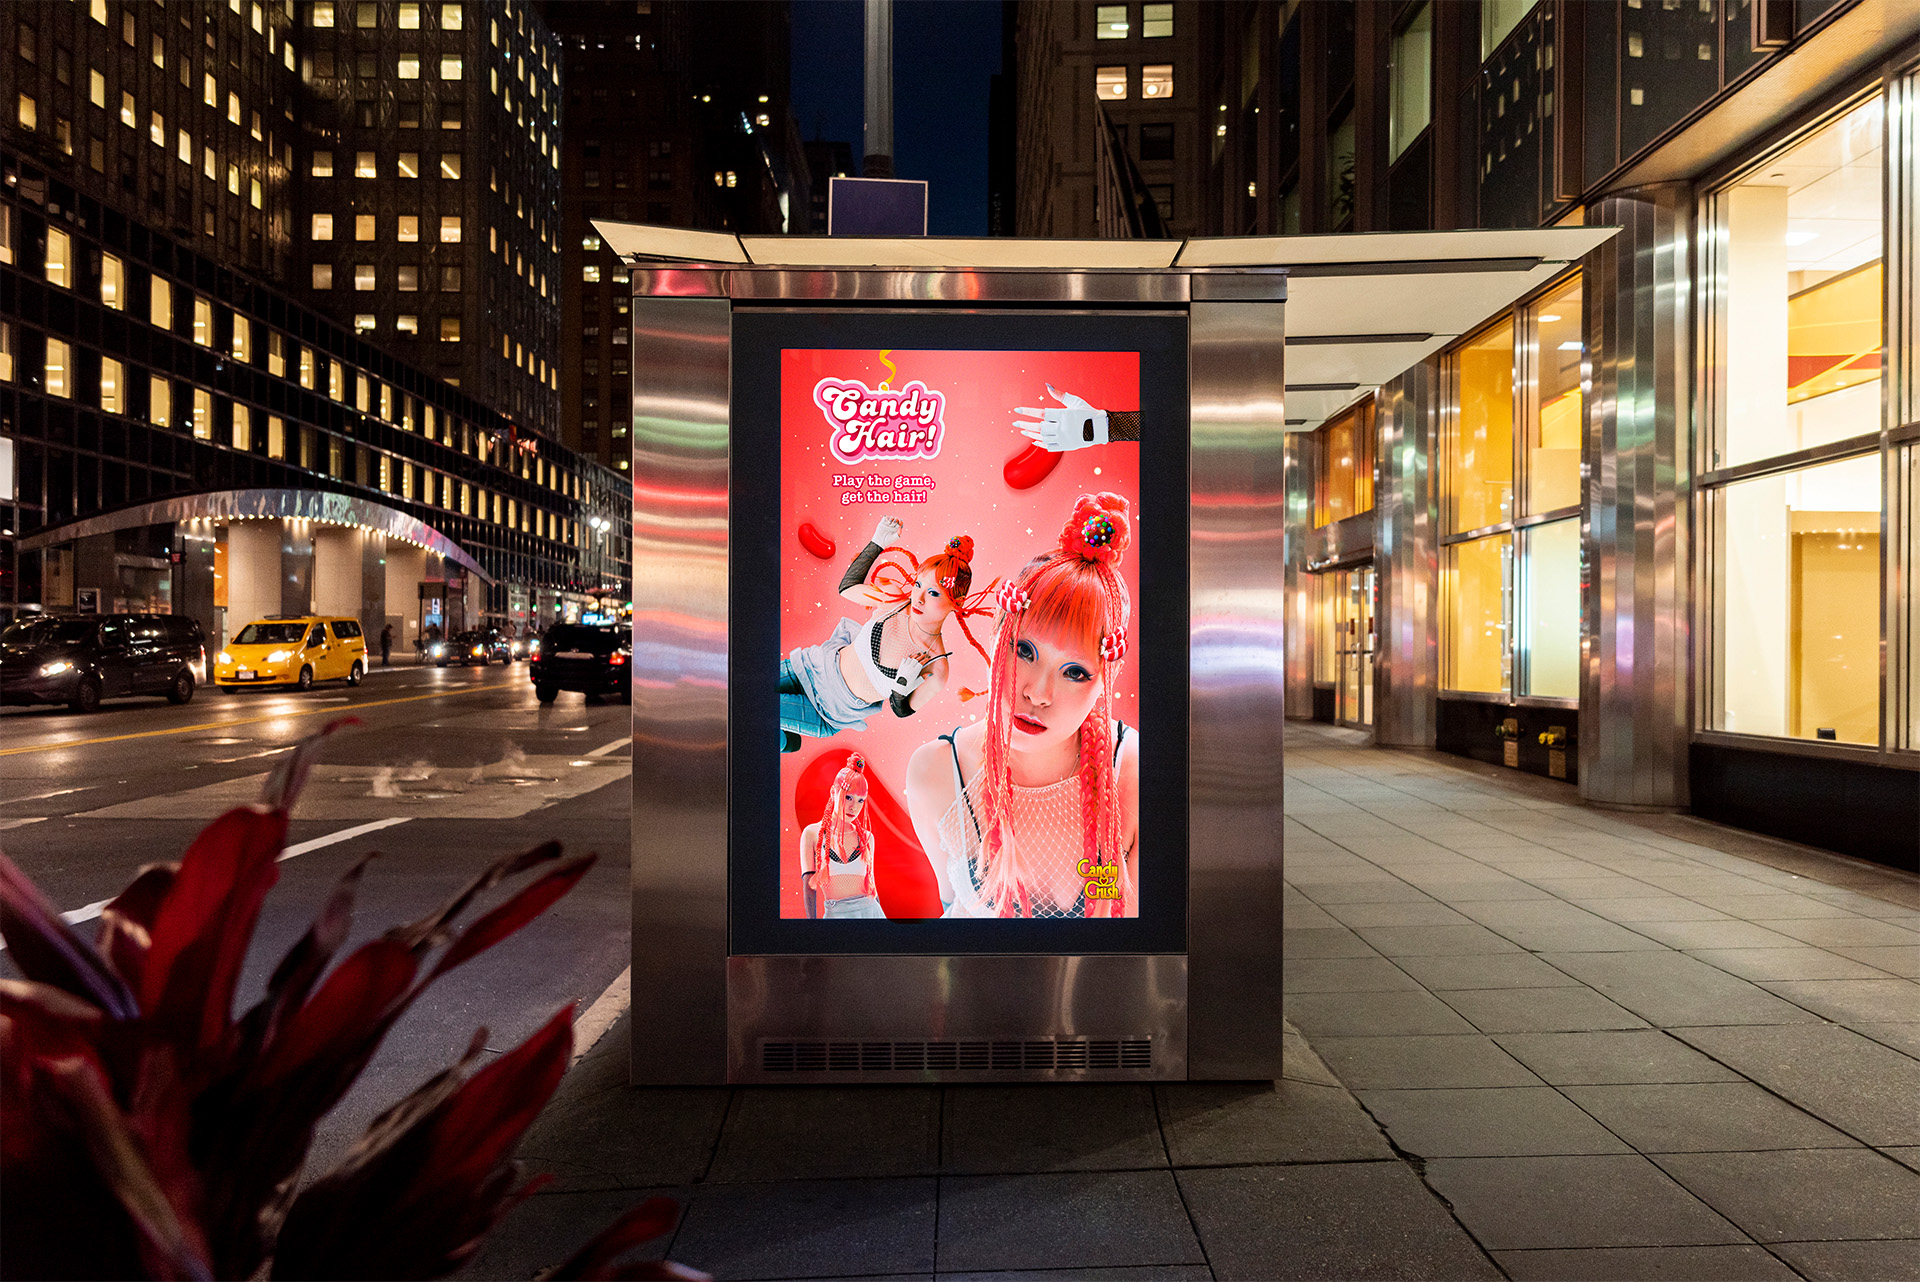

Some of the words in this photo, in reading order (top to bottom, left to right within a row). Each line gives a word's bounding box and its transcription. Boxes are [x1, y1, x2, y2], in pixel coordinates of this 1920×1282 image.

[821, 385, 938, 425] Candy
[838, 416, 937, 453] Hair!
[832, 474, 864, 489] Play
[867, 474, 891, 486] the
[894, 475, 936, 489] game,
[841, 491, 863, 505] get
[866, 491, 890, 502] the
[893, 490, 927, 502] hair!
[1077, 858, 1118, 886] Candy
[1084, 880, 1122, 900] Crush
